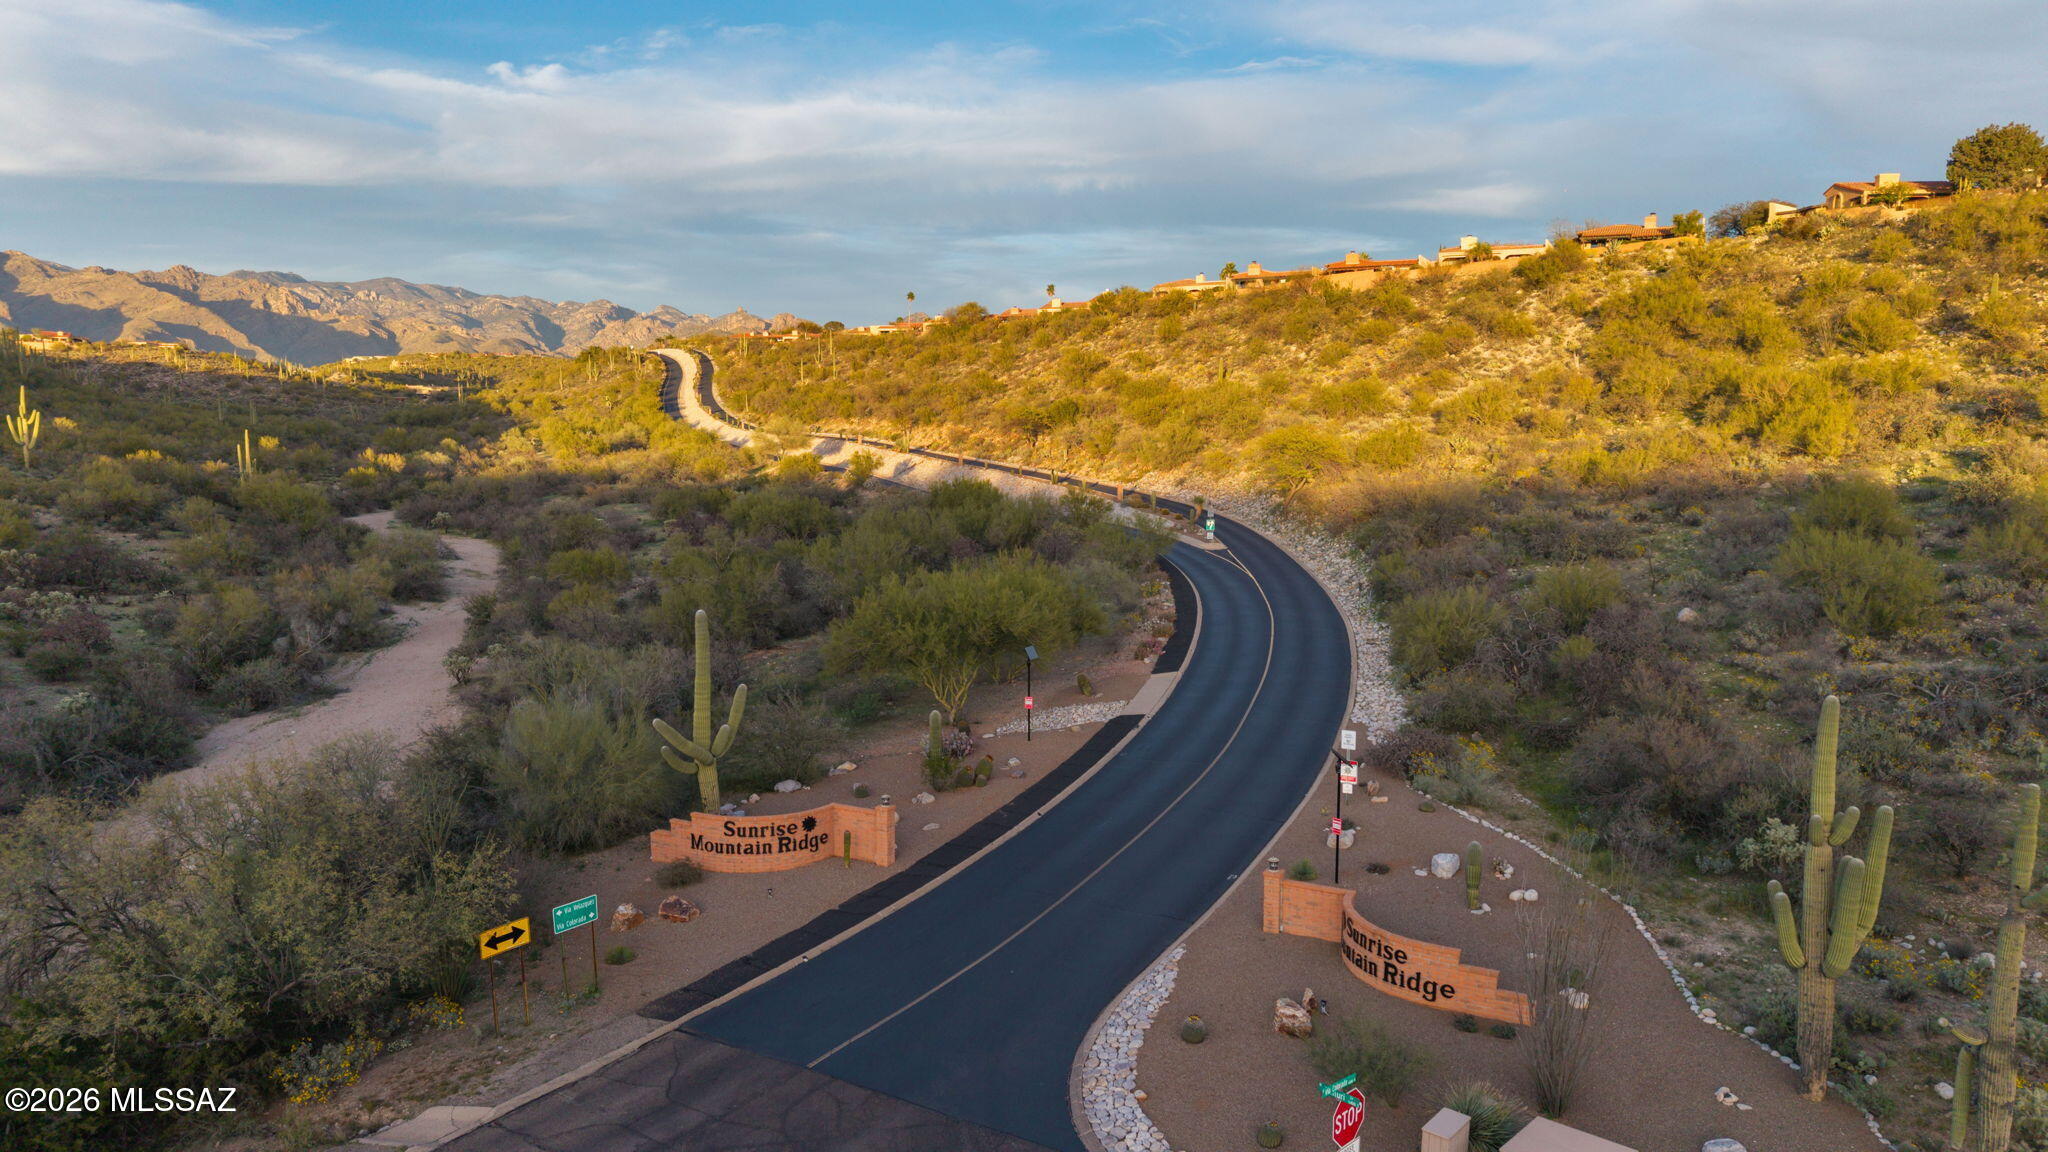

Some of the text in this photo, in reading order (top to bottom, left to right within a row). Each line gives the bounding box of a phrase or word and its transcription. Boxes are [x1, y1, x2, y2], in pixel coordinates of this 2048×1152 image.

[690, 831, 828, 855] Mountain Ridge
[723, 820, 798, 838] Sunrise
[1346, 917, 1408, 964] Sunrise
[1382, 961, 1456, 1002] Ridge
[1335, 1102, 1362, 1135] STOP
